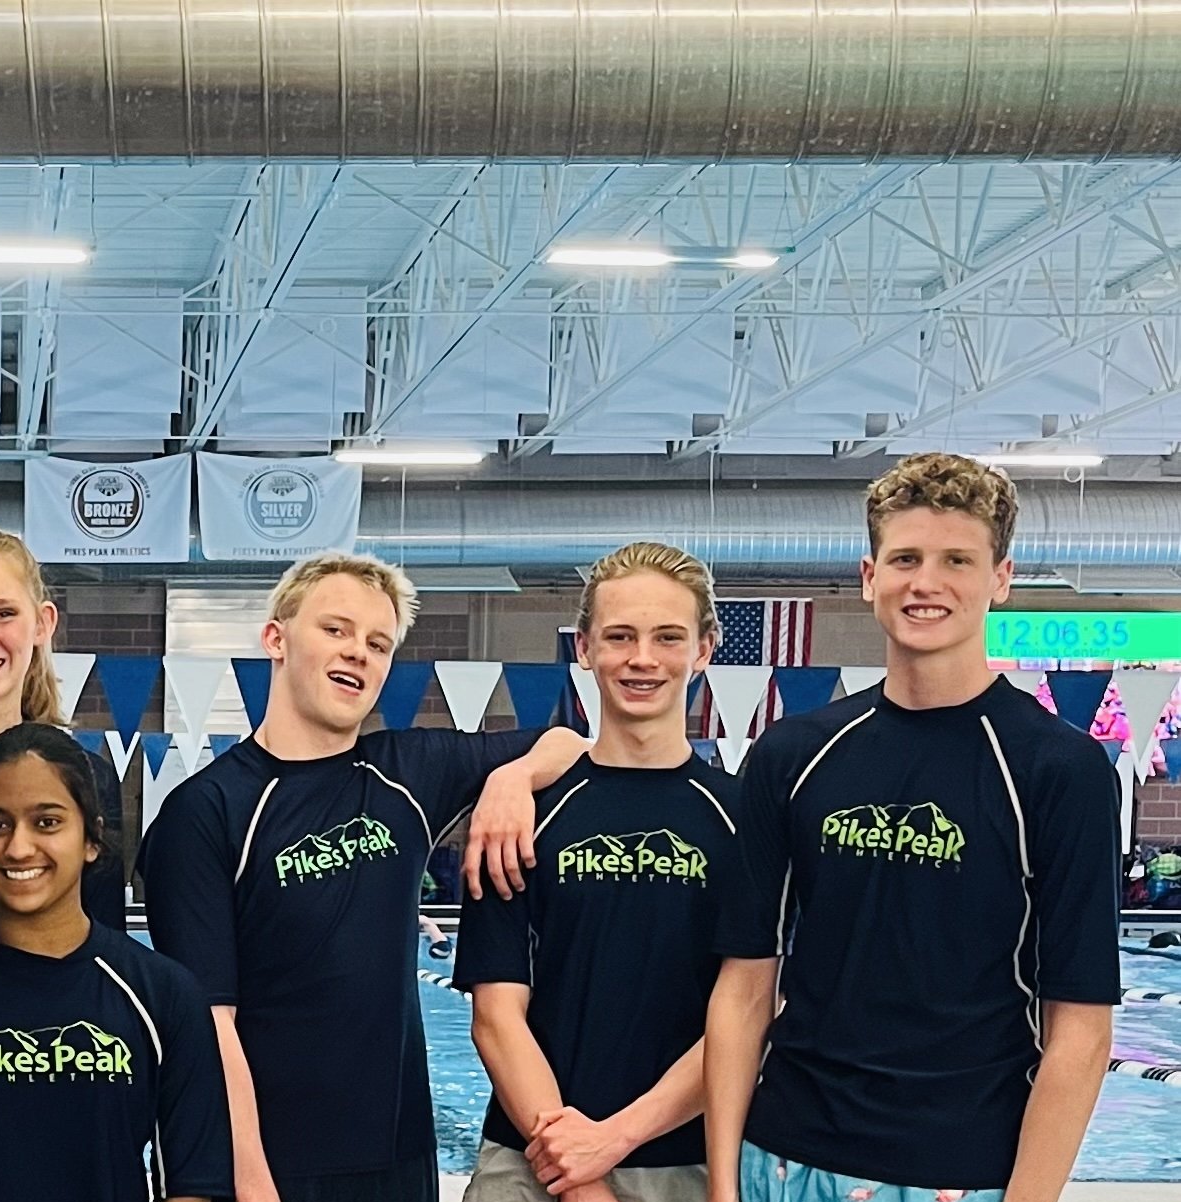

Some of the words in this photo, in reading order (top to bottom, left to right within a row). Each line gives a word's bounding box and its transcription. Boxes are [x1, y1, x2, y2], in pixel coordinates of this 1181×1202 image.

[84, 502, 134, 517] BRONZE
[260, 502, 303, 517] SILVER
[64, 547, 86, 557] PIKES
[89, 548, 108, 557] PEAK
[110, 547, 151, 556] ATHLETICS
[260, 548, 280, 556] PEAK
[998, 619, 1129, 647] 12:06:35
[276, 849, 344, 879] Pikes
[342, 826, 397, 861] Peak
[822, 818, 894, 849] Pikes
[895, 825, 966, 862] Peak
[558, 848, 634, 875] Pikes
[638, 848, 708, 879] Peak
[54, 1044, 132, 1075] Peak
